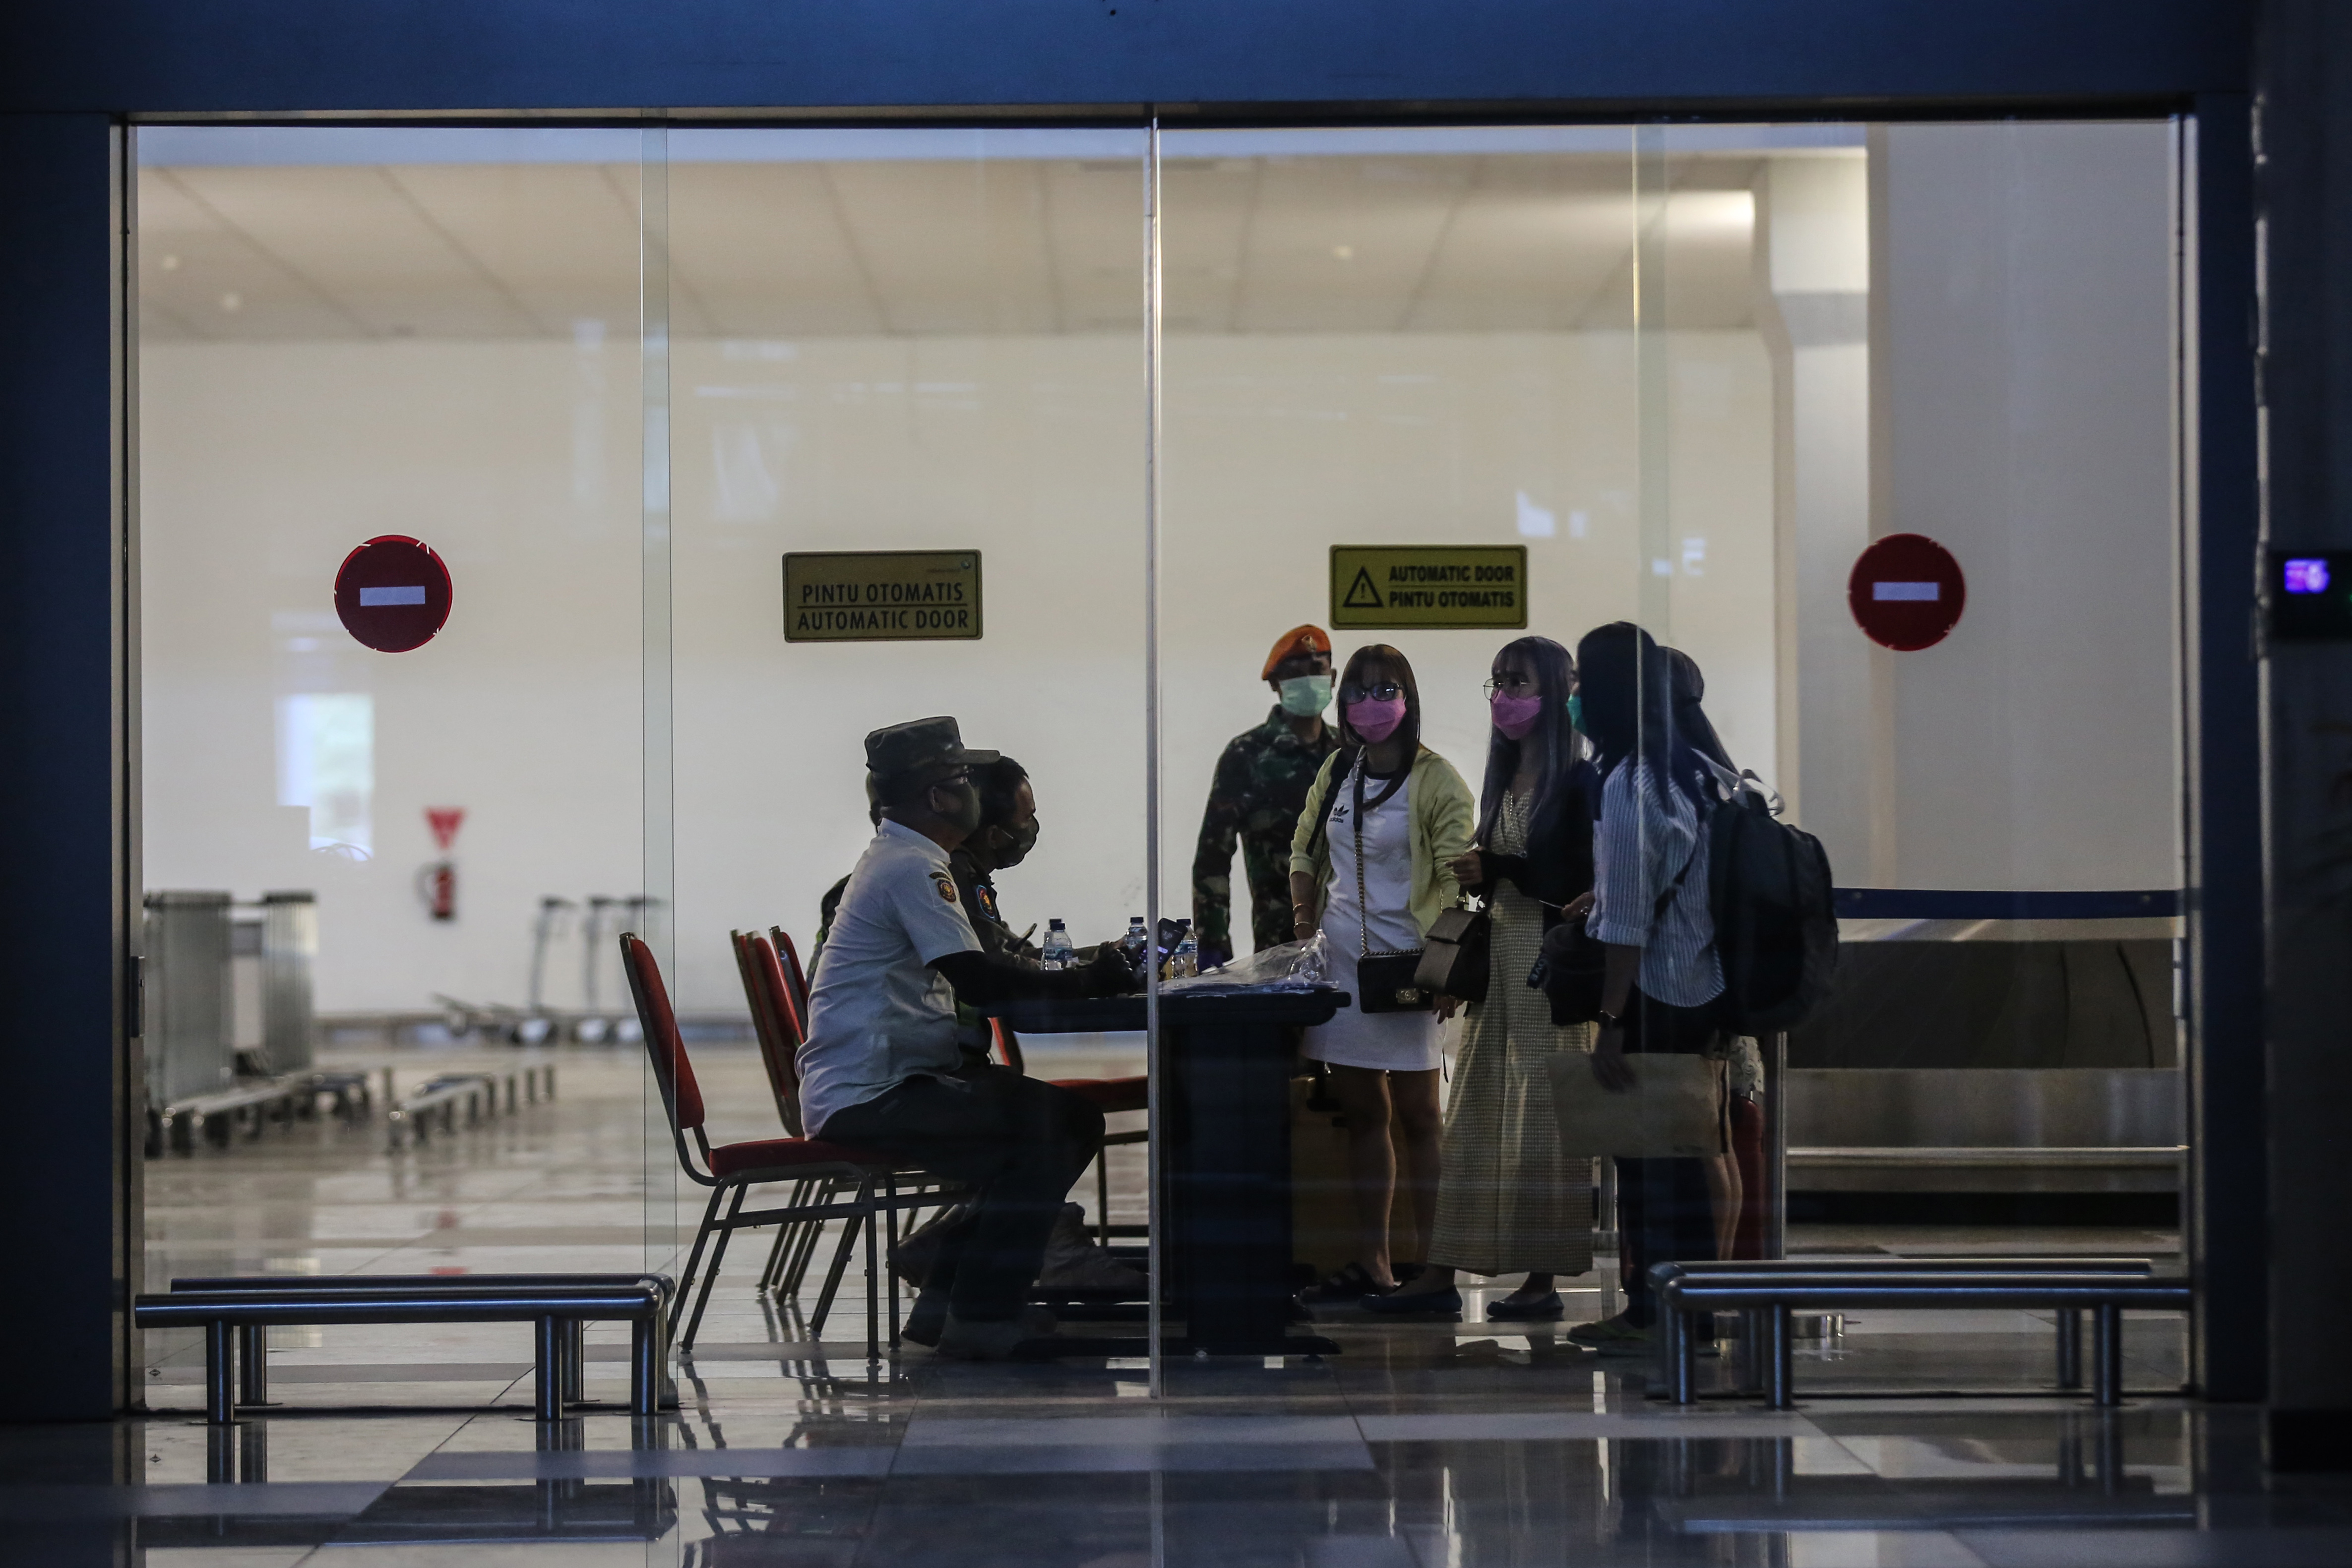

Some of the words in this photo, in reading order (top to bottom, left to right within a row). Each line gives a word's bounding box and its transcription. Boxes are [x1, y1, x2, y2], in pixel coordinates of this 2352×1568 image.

[1388, 565, 1471, 583] AUTOMATIC
[1475, 565, 1514, 582] DOOR
[803, 583, 859, 603] PINTU
[866, 582, 963, 603] OTOMATIS
[1389, 591, 1434, 608] PINTU
[1438, 591, 1515, 608] OTOMATIS
[797, 610, 909, 631] AUTOMATIC
[916, 609, 969, 629] DOOR
